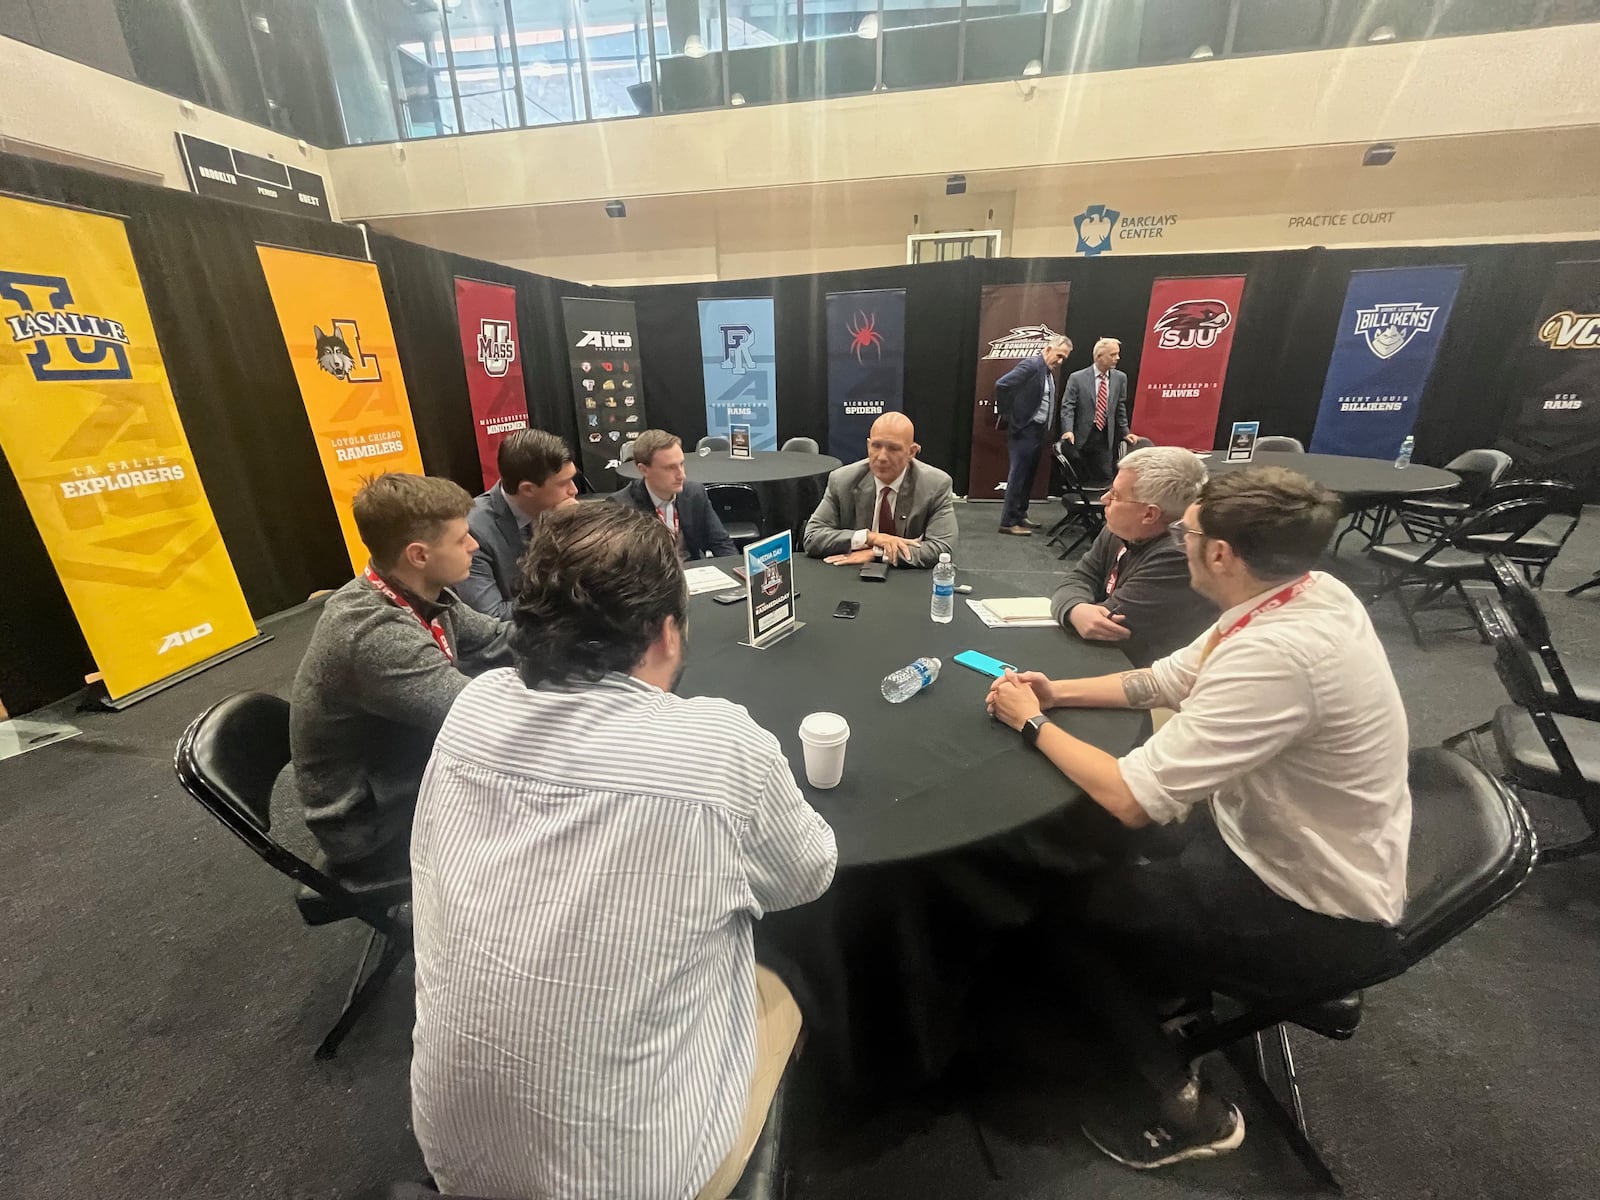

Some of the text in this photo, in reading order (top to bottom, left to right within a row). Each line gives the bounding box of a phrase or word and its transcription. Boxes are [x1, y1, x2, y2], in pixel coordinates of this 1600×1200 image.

[199, 166, 237, 185] BROOKLYN
[257, 187, 278, 198] PERIOD
[298, 193, 320, 206] GUEST
[1121, 214, 1177, 227] BARCLAYS
[1288, 211, 1396, 228] PRACTICE COURT
[1119, 227, 1164, 239] CENTER
[1360, 311, 1430, 330] BILLIKENS
[575, 330, 633, 348] A10
[1162, 329, 1215, 347] SJU
[1555, 315, 1600, 347] VC
[991, 349, 1042, 358] BONNIE
[1162, 389, 1200, 398] HAWKS
[727, 407, 752, 415] RAMS
[845, 406, 883, 415] SPIDERS
[1340, 402, 1402, 412] BILLIKENS
[1543, 400, 1583, 410] RAMS
[331, 430, 401, 448] LOYOLA CHICAGO
[335, 440, 404, 462] RAMBLERS
[73, 455, 168, 477] LA SALLE
[59, 465, 185, 499] EXPLORERS
[156, 622, 213, 655] A10
